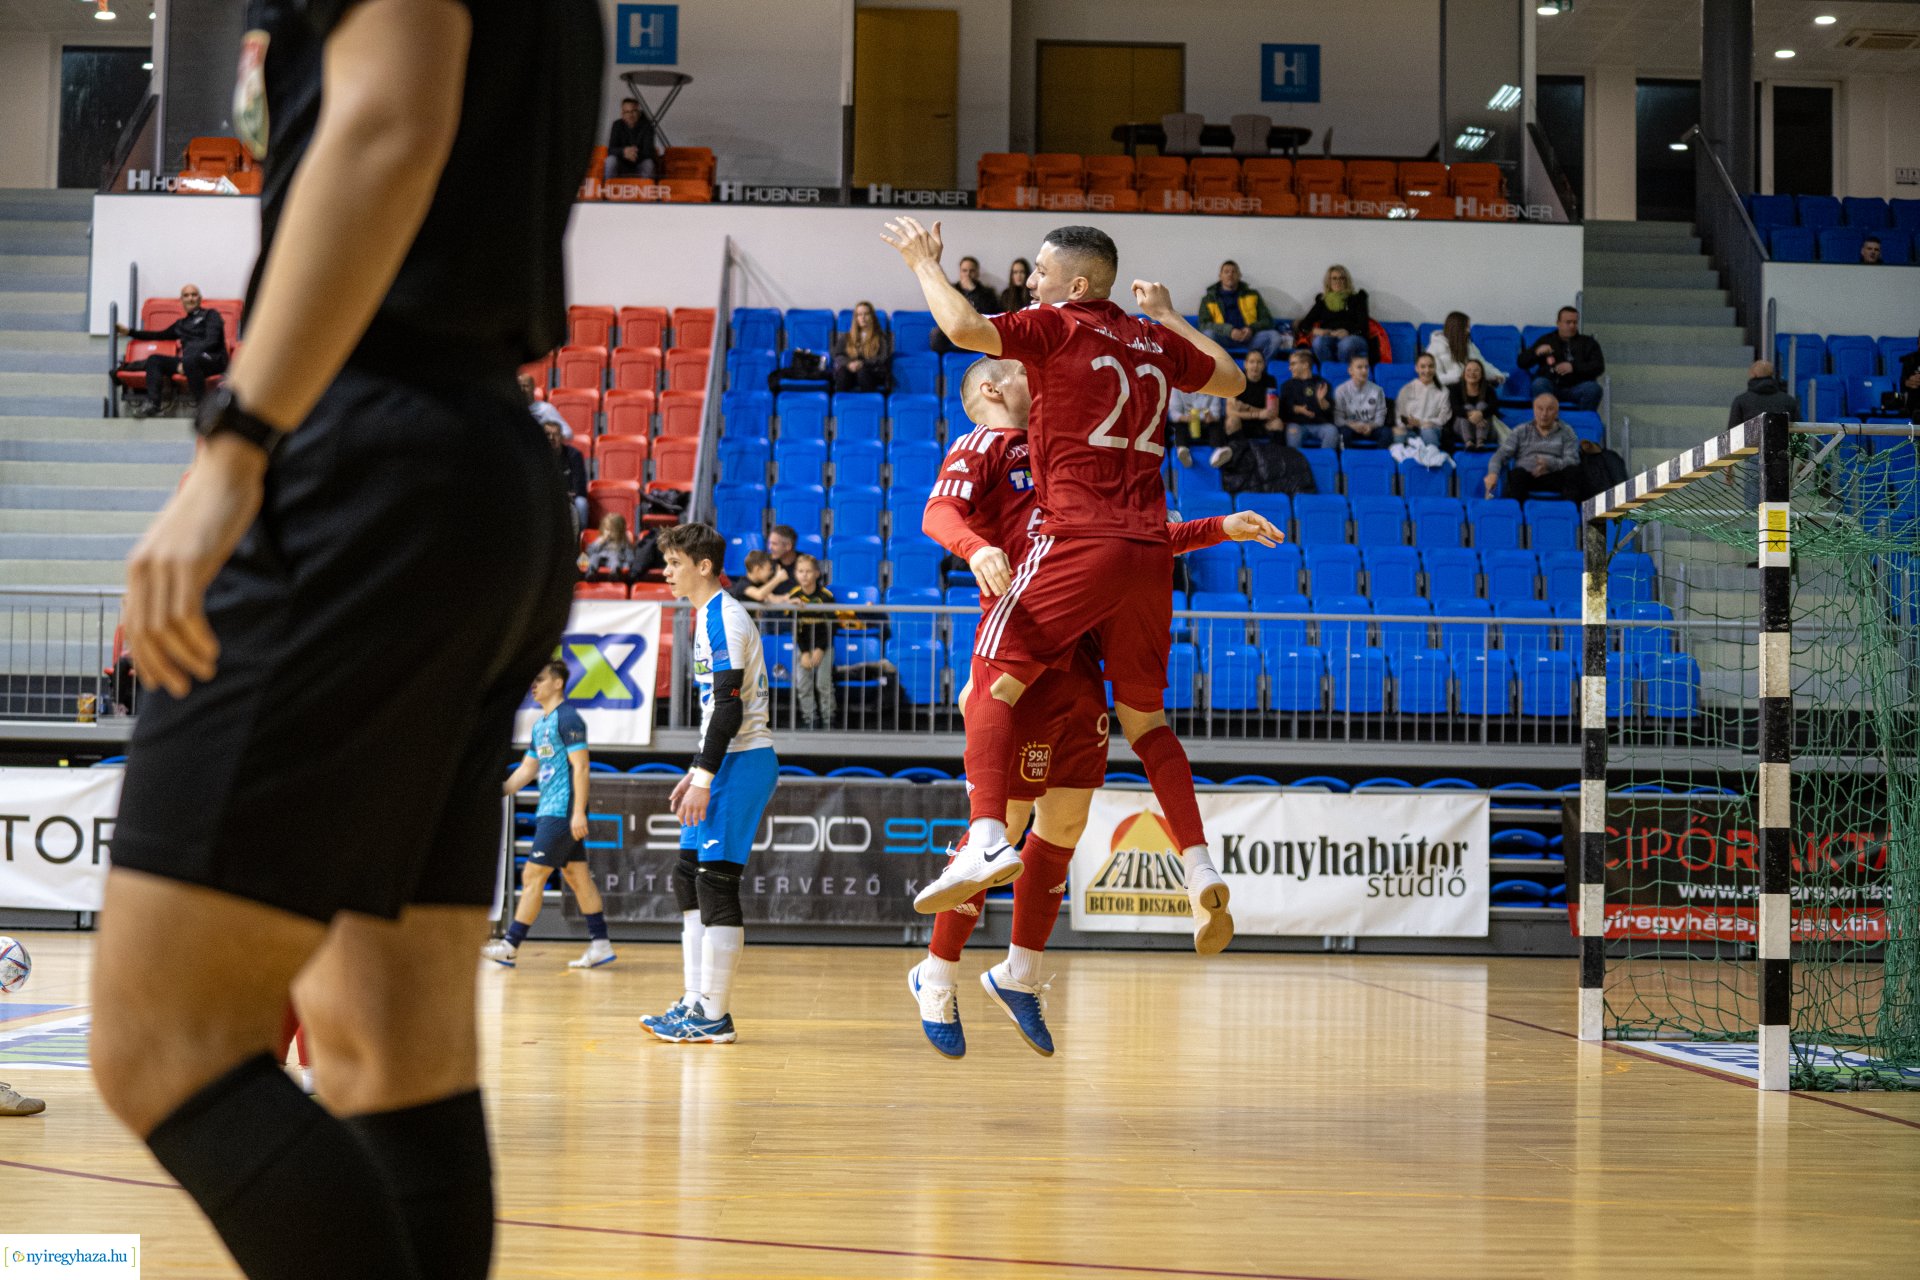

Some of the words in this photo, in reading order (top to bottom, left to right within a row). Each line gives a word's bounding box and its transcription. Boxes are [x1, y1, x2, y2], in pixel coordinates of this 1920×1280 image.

[597, 184, 671, 198] HÜBNER
[746, 187, 820, 202] HÜBNER
[894, 190, 969, 206] HÜBNER
[1041, 193, 1115, 208] HÜBNER
[1190, 197, 1262, 212] HÜBNER
[1480, 202, 1553, 218] HÜBNER
[1088, 355, 1168, 457] 22
[1096, 712, 1110, 748] 9
[1028, 750, 1048, 762] 99.4
[1031, 768, 1043, 777] FM
[1221, 834, 1468, 881] Konyhabútor
[753, 873, 881, 895] ERVEZŐ
[1367, 868, 1467, 897] stúdió
